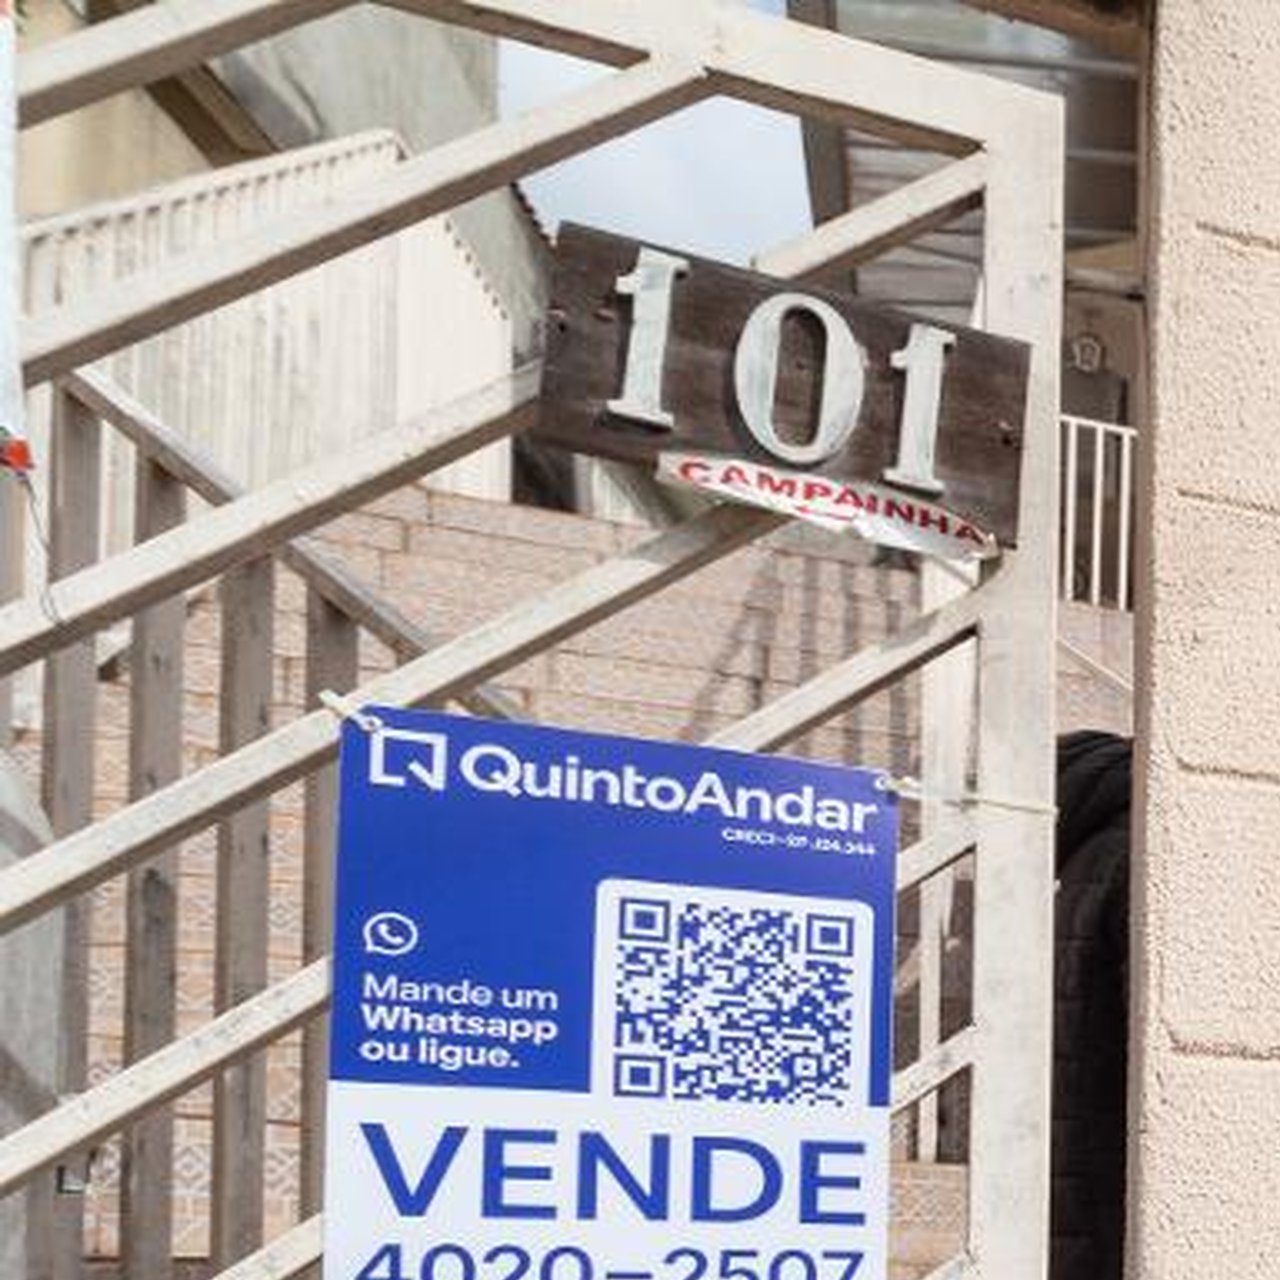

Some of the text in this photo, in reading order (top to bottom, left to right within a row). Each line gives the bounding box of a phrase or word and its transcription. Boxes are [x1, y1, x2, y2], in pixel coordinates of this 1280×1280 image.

[605, 245, 956, 494] 101
[676, 458, 987, 545] CAMPAINHA
[460, 744, 878, 833] QuintoAndar
[361, 1004, 559, 1045] Whatsapp
[362, 973, 559, 1010] Mande um
[359, 1037, 520, 1071] ou ligue.
[360, 1122, 866, 1226] VENDE
